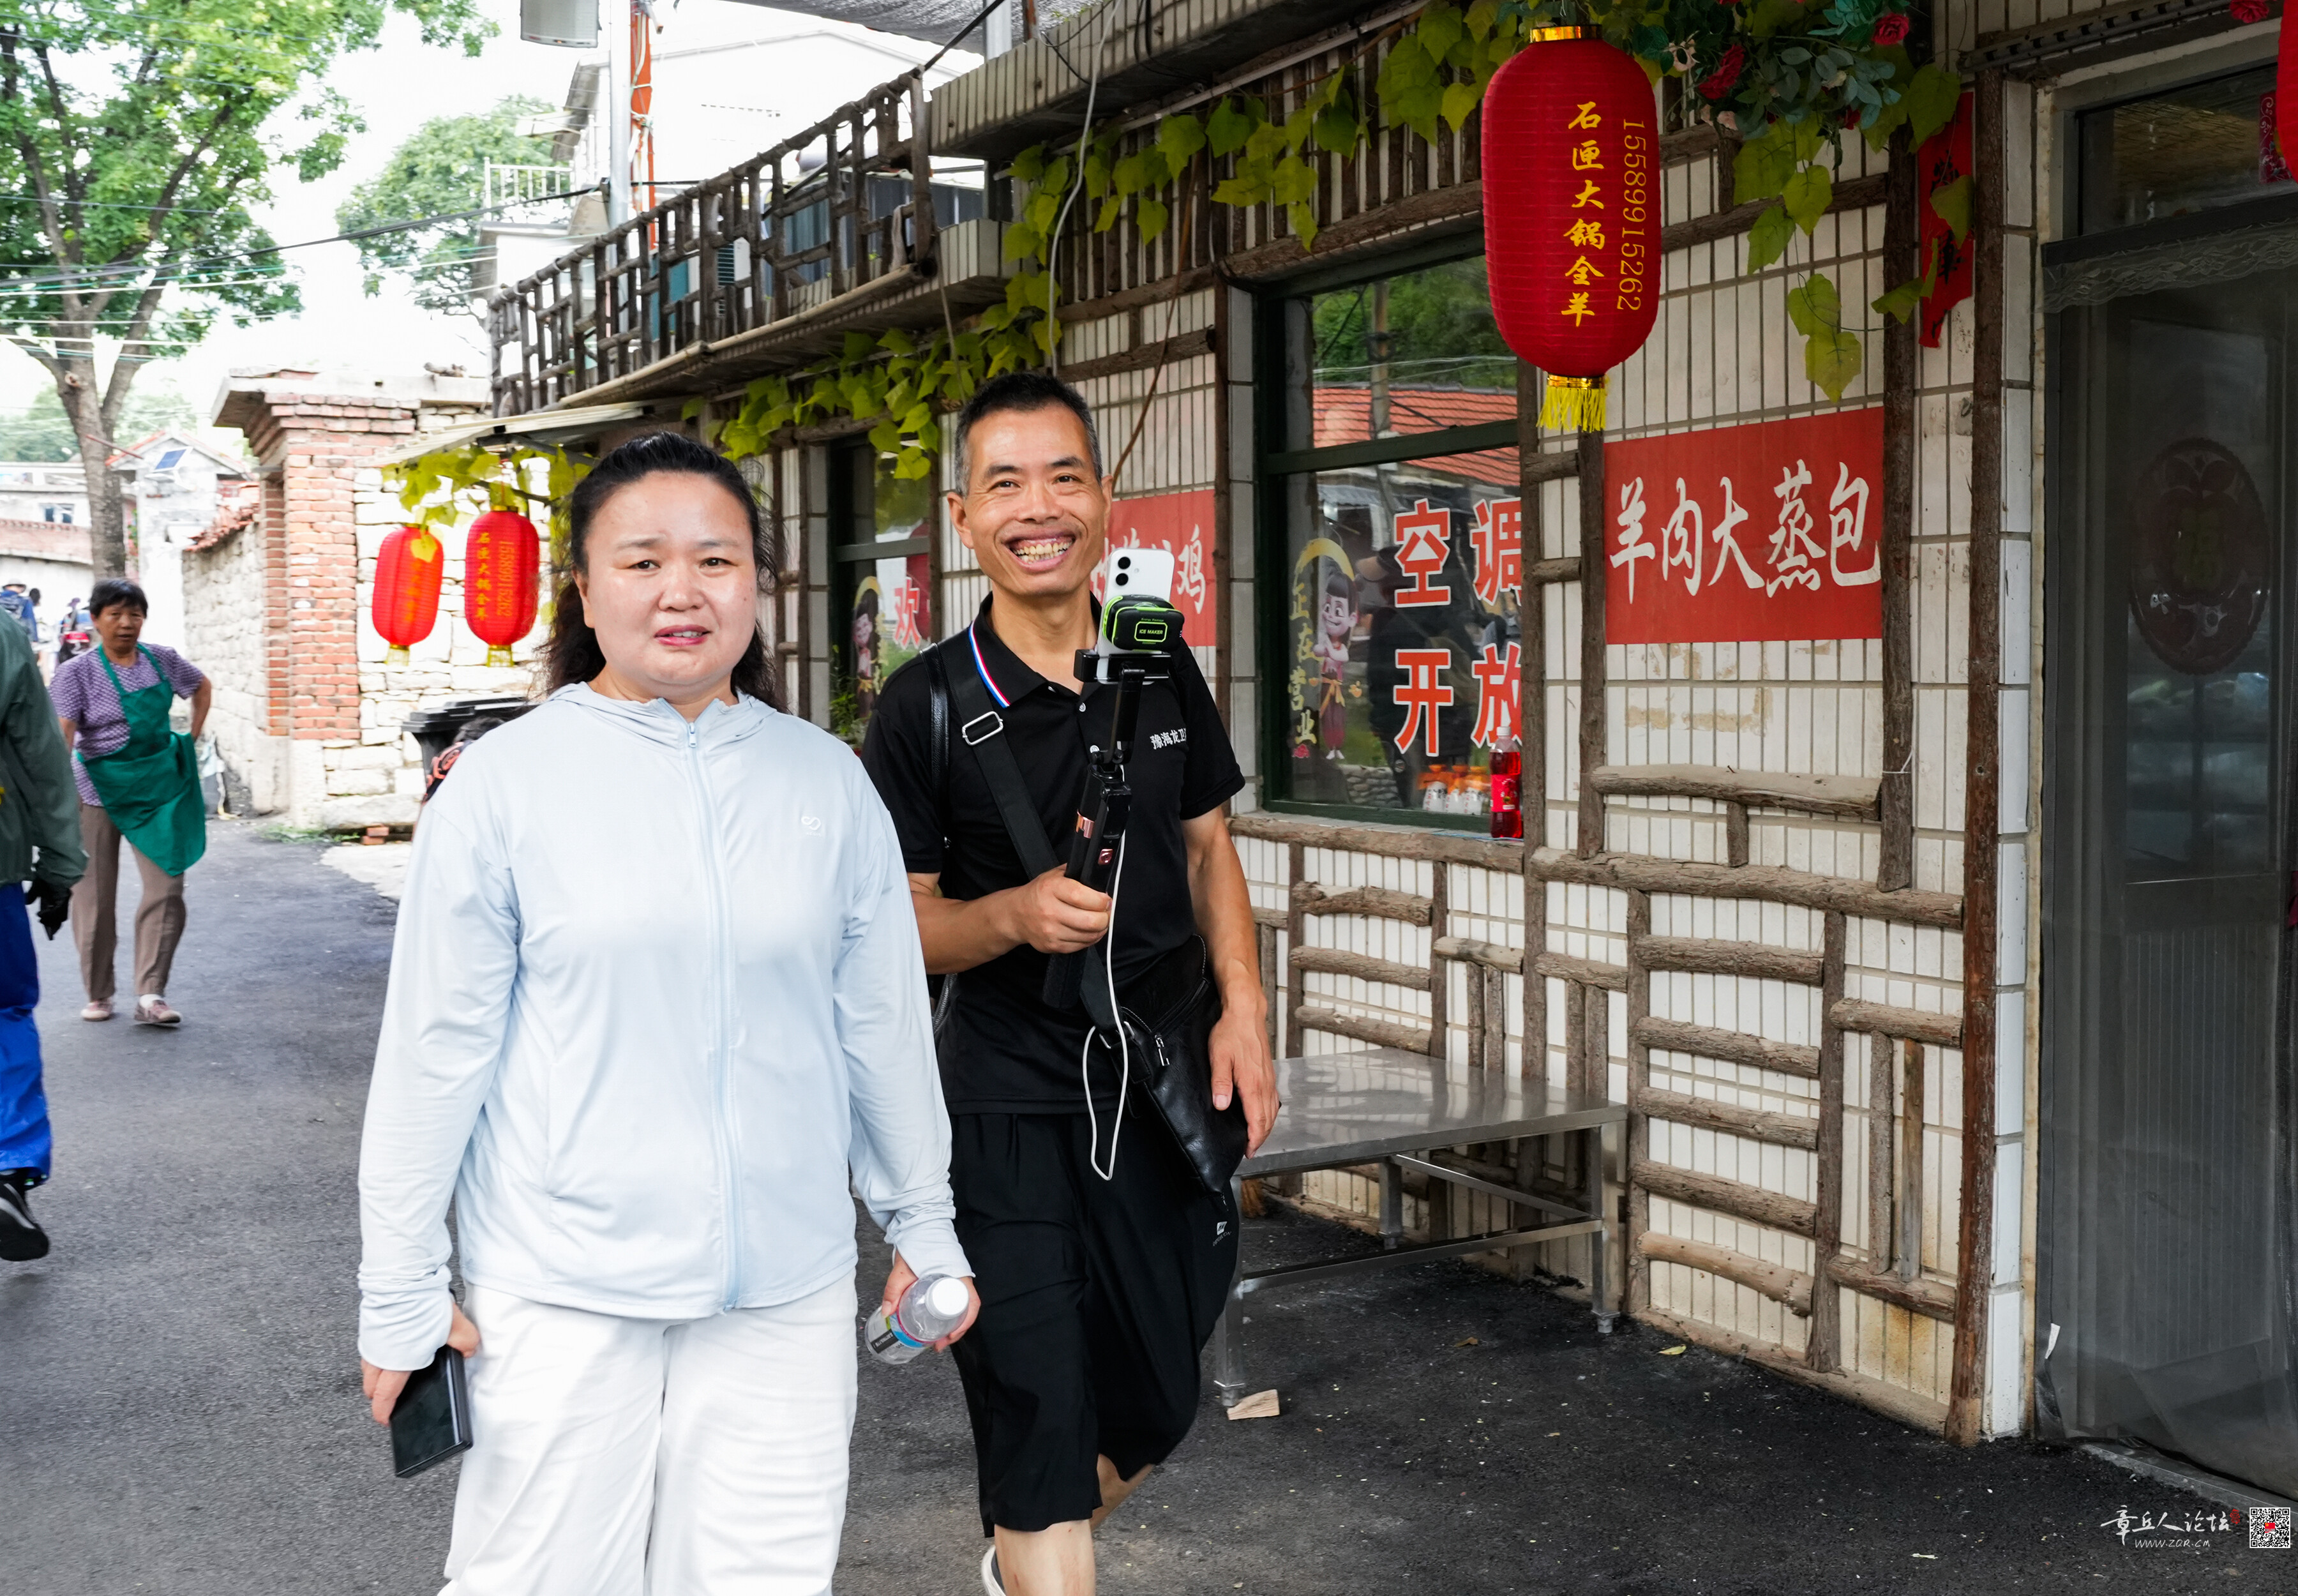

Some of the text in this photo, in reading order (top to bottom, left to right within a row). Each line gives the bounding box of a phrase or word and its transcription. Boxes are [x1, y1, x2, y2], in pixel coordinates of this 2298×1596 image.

[1561, 101, 1605, 327] 石匣大锅全羊
[1617, 119, 1647, 312] 15589915262
[1609, 459, 1882, 605] 羊肉大蒸包
[1150, 728, 1187, 750] 豫海龙卫
